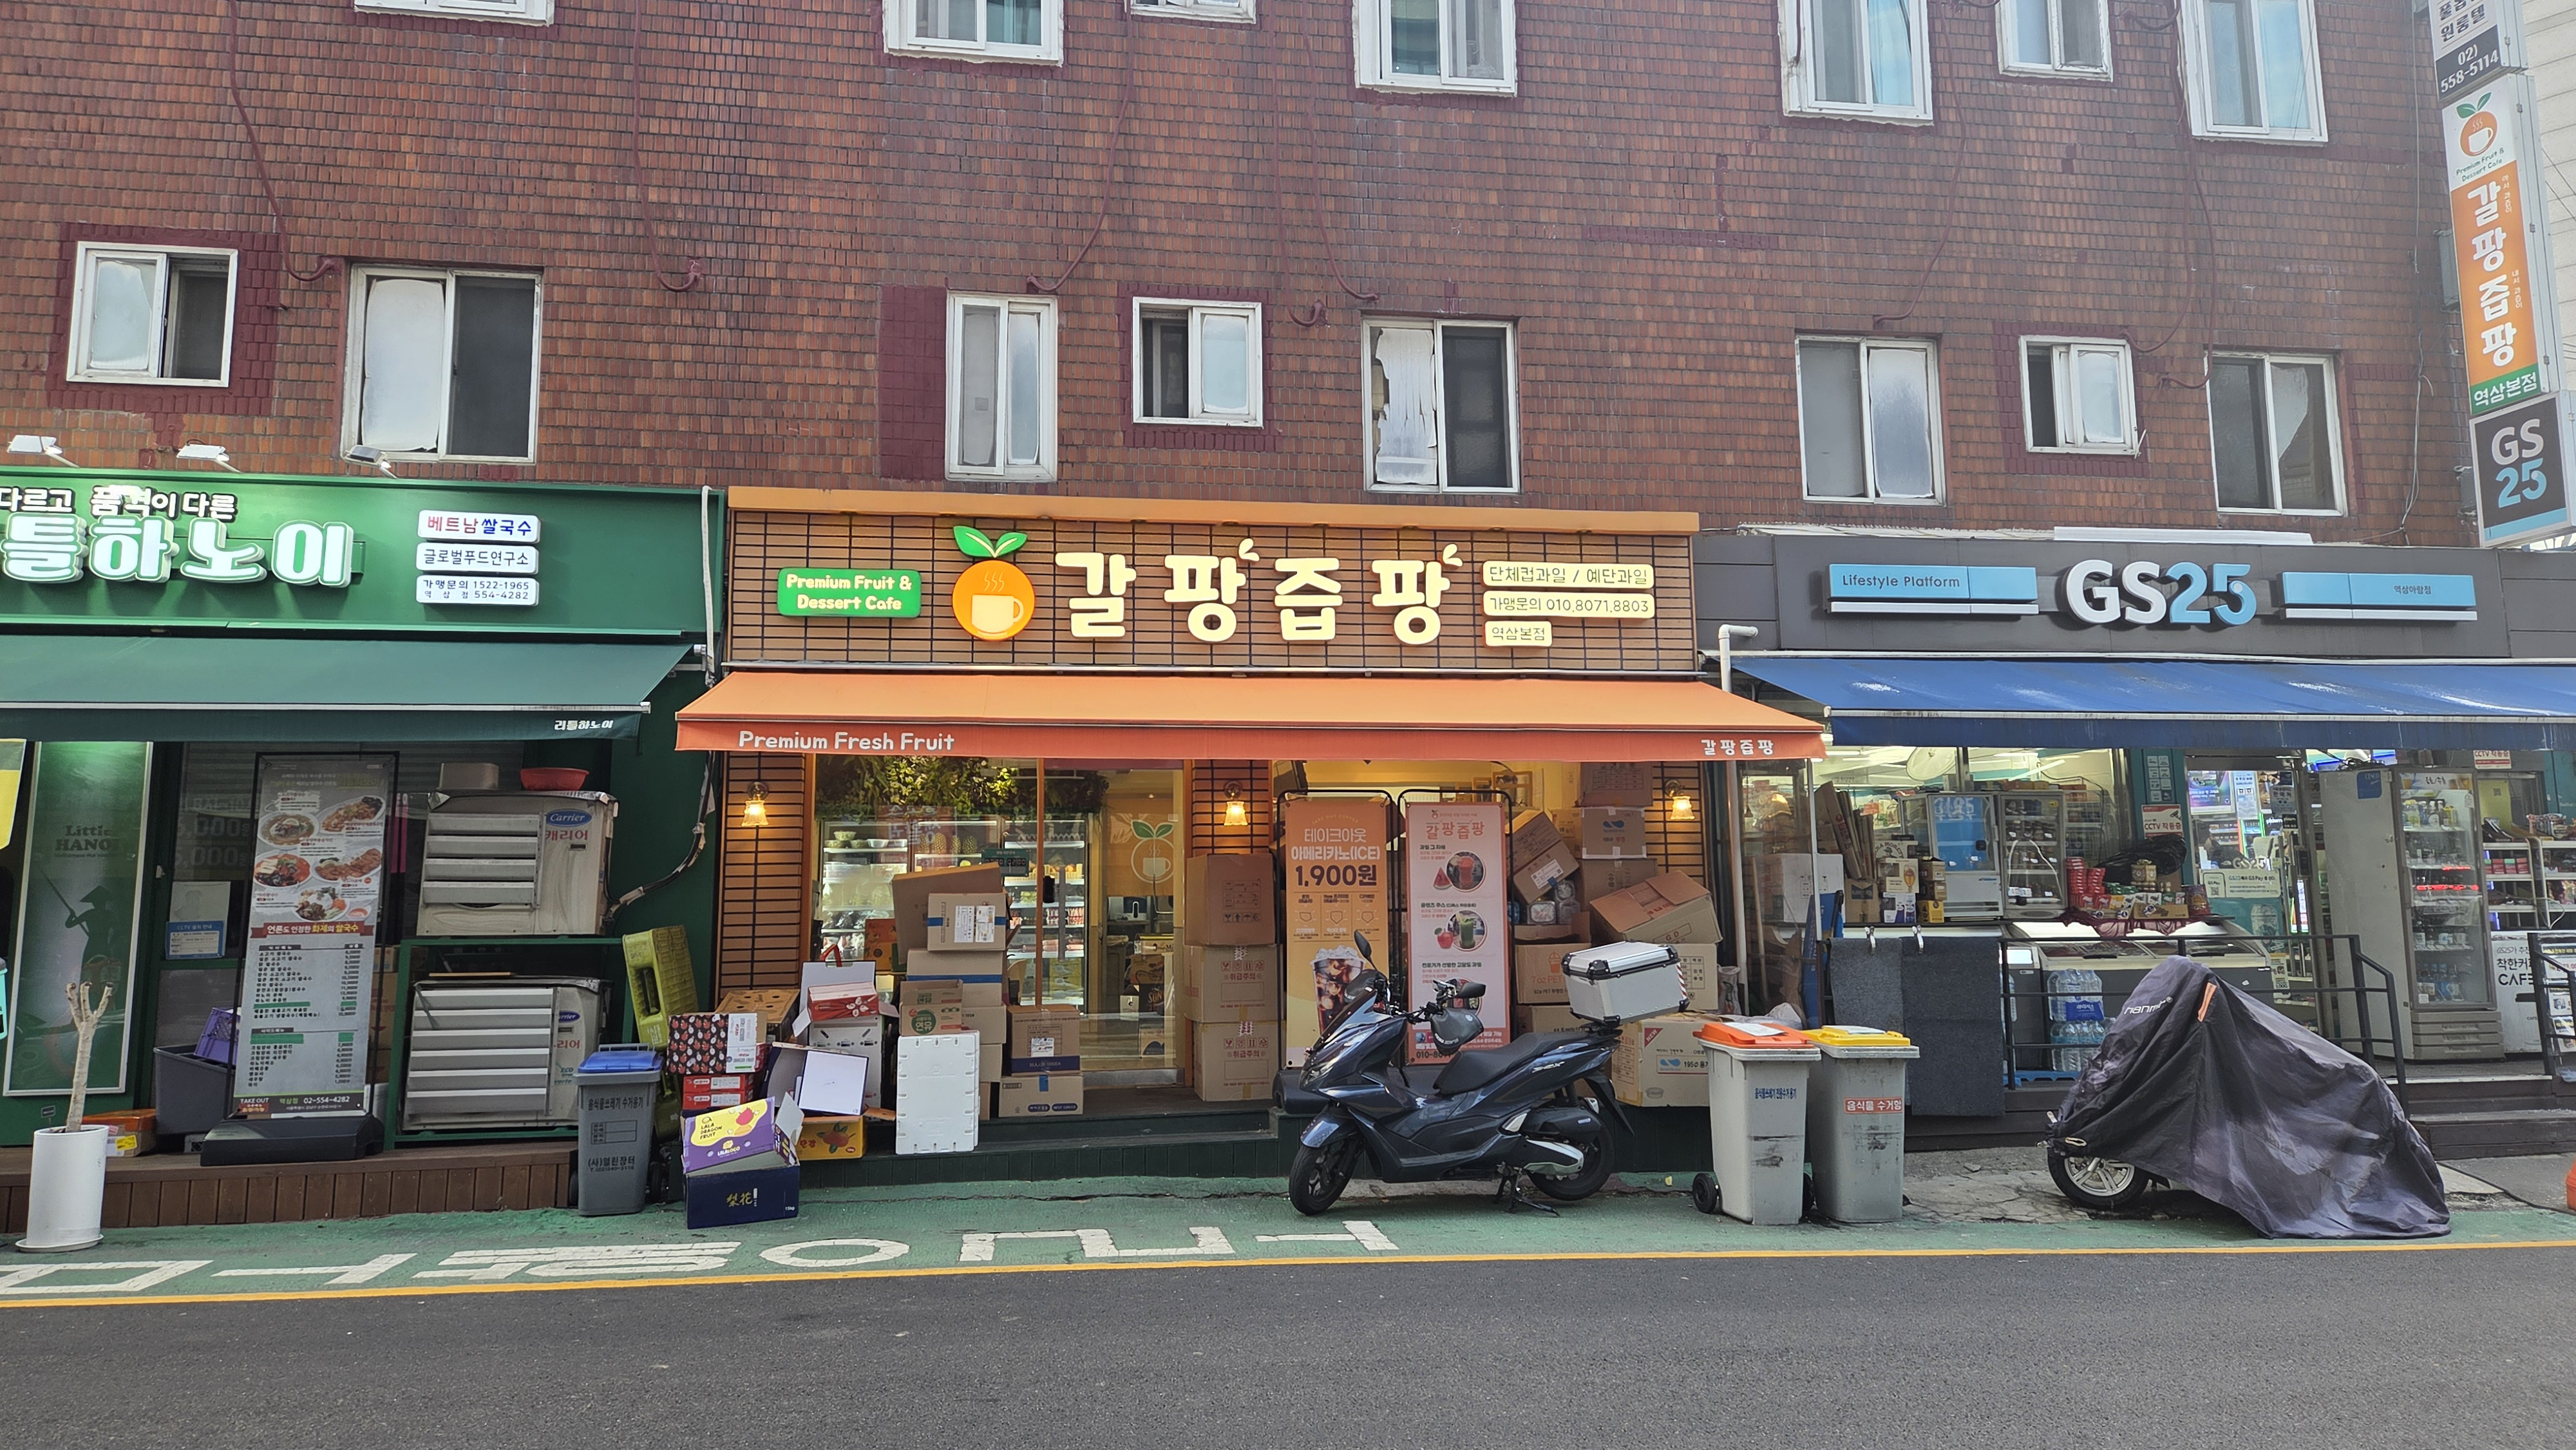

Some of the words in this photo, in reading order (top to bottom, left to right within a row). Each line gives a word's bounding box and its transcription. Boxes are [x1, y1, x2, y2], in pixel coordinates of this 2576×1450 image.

[2441, 4, 2485, 42] 원룸텔
[2458, 44, 2477, 65] 02)
[2441, 50, 2499, 92] 558-5114
[2456, 160, 2481, 176] Premium
[2481, 150, 2497, 164] Fruit
[2462, 167, 2486, 182] Dessert
[2488, 158, 2503, 169] Cafe
[2468, 181, 2517, 367] 갈팡즙팡
[2474, 372, 2537, 406] 역삼본점
[2492, 419, 2544, 465] GS
[2496, 458, 2547, 507] 25
[91, 484, 176, 517] 품격이
[182, 493, 238, 519] 다른
[428, 516, 478, 534] 베트남
[481, 518, 532, 536] 쌀국수
[424, 549, 529, 566] 글로벌푸드연구소
[786, 573, 851, 589] Premium
[854, 575, 895, 590] Fruit
[899, 575, 912, 591] &
[1490, 567, 1566, 583] 단체컵과일
[1587, 569, 1647, 585] 예단과일
[1842, 575, 1899, 589] Lifestyle
[1904, 576, 1960, 587] Platform
[422, 579, 468, 589] 가맹문의
[473, 581, 529, 590] 1522-1965
[2065, 559, 2257, 625] GS25
[2394, 585, 2432, 595] 역삼아람점
[474, 590, 529, 599] 554-4282
[797, 594, 862, 610] Dessert
[865, 595, 902, 610] Cafe
[1055, 545, 1454, 645] 갈팡즙팡
[1490, 598, 1541, 611] 가맹문의
[1546, 599, 1649, 612] 010.8071.8803
[1492, 627, 1545, 641] 역삼본점
[554, 720, 614, 731] 리틀하노이
[739, 730, 828, 749] Premium
[835, 731, 894, 750] Fresh
[900, 732, 954, 751] Fruit
[1701, 739, 1774, 756] 갈팡즙팡
[549, 812, 585, 823] Carrier
[1426, 821, 1485, 840] 갈팡즙팡
[2162, 822, 2182, 831] 작동중
[1304, 828, 1367, 843] 테이크아웃
[1291, 845, 1380, 861] 아메리카노(ICE)
[1295, 864, 1377, 887] 1,900원
[2496, 957, 2531, 970] 착한커
[1646, 1029, 1658, 1042] NEW
[557, 1039, 580, 1049] 리어
[303, 1096, 350, 1104] 02-554-4282
[588, 1097, 620, 1111] 음식물쓰레기
[622, 1096, 643, 1109] 수거용기
[1846, 1100, 1874, 1111] 음식물
[699, 1132, 716, 1140] FRUIT
[700, 1125, 723, 1135] DRAGON
